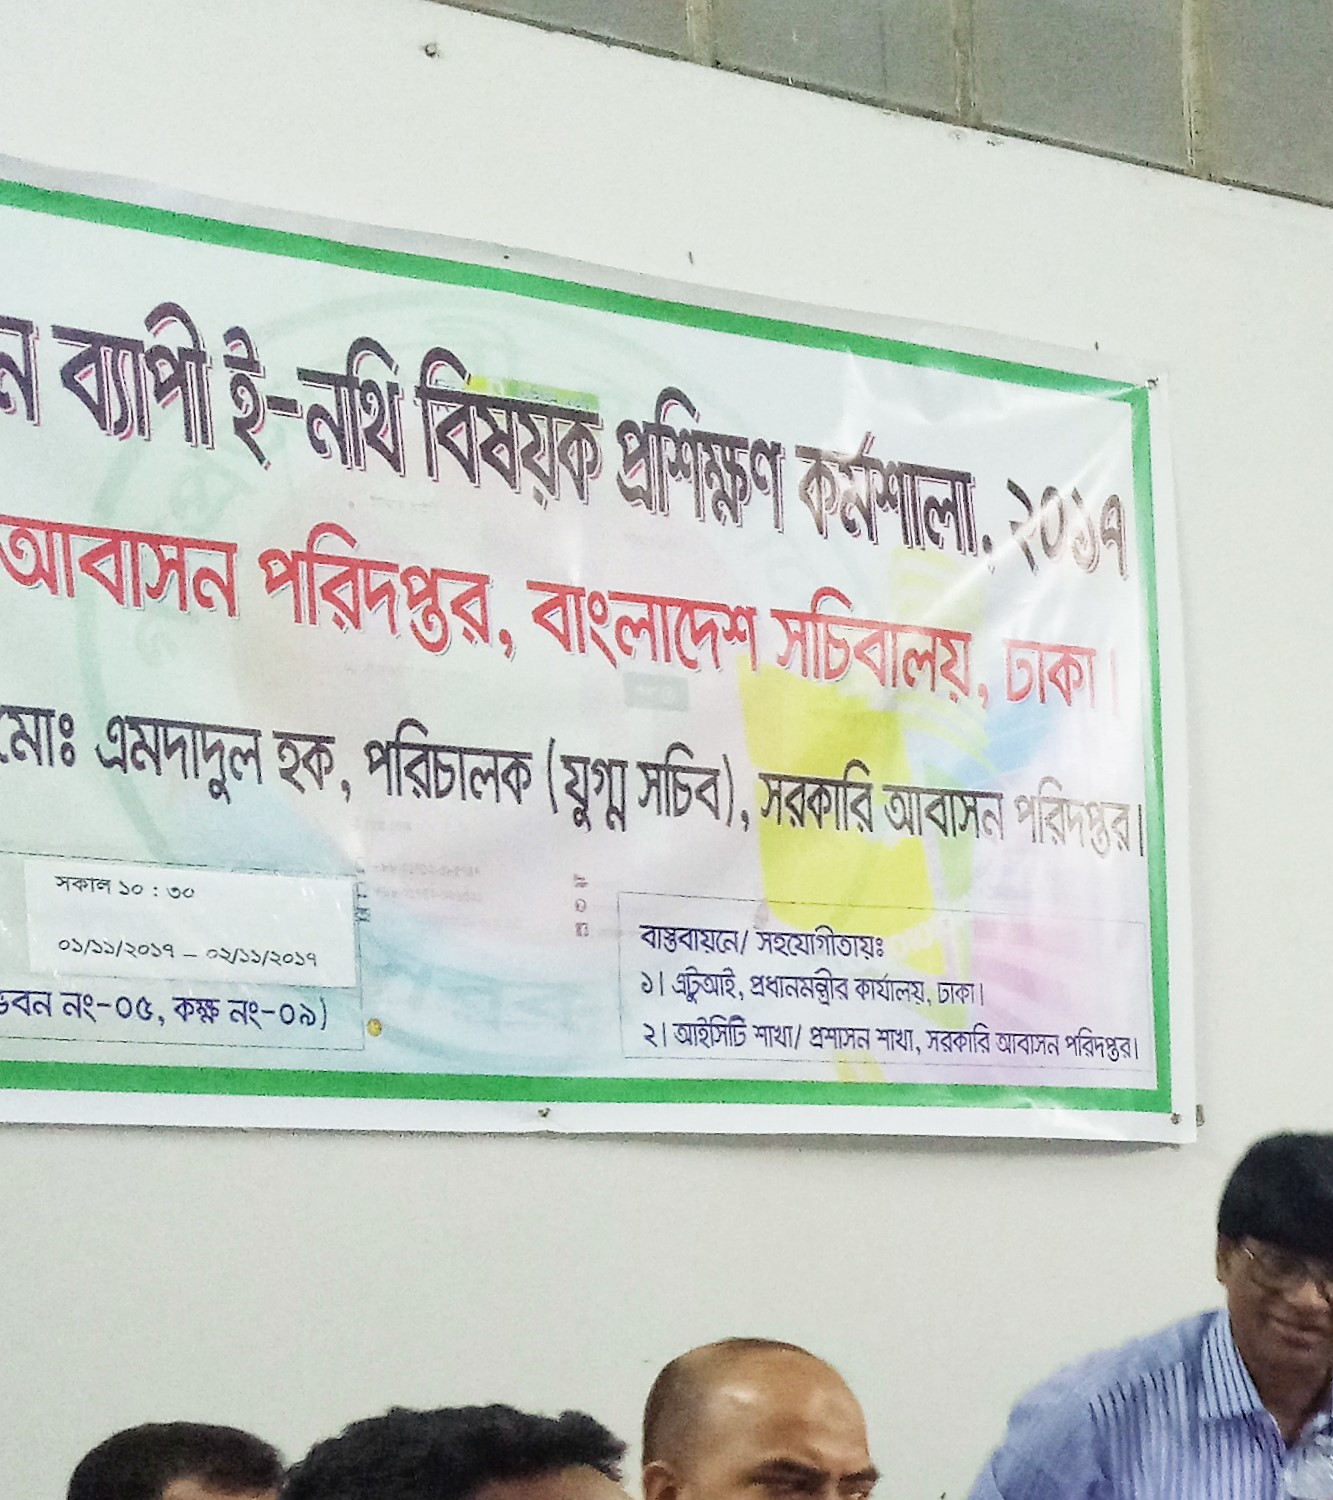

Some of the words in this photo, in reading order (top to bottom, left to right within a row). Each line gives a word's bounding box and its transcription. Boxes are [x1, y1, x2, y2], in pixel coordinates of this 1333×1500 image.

[51, 302, 215, 450] ব্যাপী
[223, 325, 405, 477] ই-নথি
[414, 346, 602, 509] বিষয়ক
[616, 386, 785, 533] প্রশিক্ষণ
[1006, 478, 1129, 581] ২০১৭
[0, 514, 239, 619] আবাসন
[258, 522, 515, 661] পরিদপ্তর,
[527, 579, 759, 673] বাংলাদেশ
[770, 586, 989, 710] সচিবালয়,
[96, 715, 261, 804] এমদাদুল
[273, 730, 351, 803] হক,
[364, 717, 533, 805] পরিচালক
[547, 737, 628, 831] (যুগ্ম
[637, 741, 749, 833] সচিব),
[758, 759, 874, 833] সরকারি
[882, 783, 1004, 841] আবাসন
[1014, 776, 1145, 858] পরিদপ্তর।
[55, 876, 111, 895] সকাল
[58, 938, 175, 959] ০১/১১/২০১৭
[206, 947, 318, 967] ০২/১১/২০১৭
[639, 925, 748, 955] বাস্তবায়নে/
[750, 967, 849, 1005] প্রধানমন্ত্রীর
[172, 997, 220, 1024] কক্ষ
[753, 1024, 802, 1050] শাখা/
[809, 1026, 870, 1050] প্রশাসন
[875, 1028, 921, 1055] শাখা,
[926, 1022, 990, 1054] সরকারি
[995, 1032, 1060, 1056] আবাসন
[1065, 1027, 1139, 1062] পরিদপ্তর।
